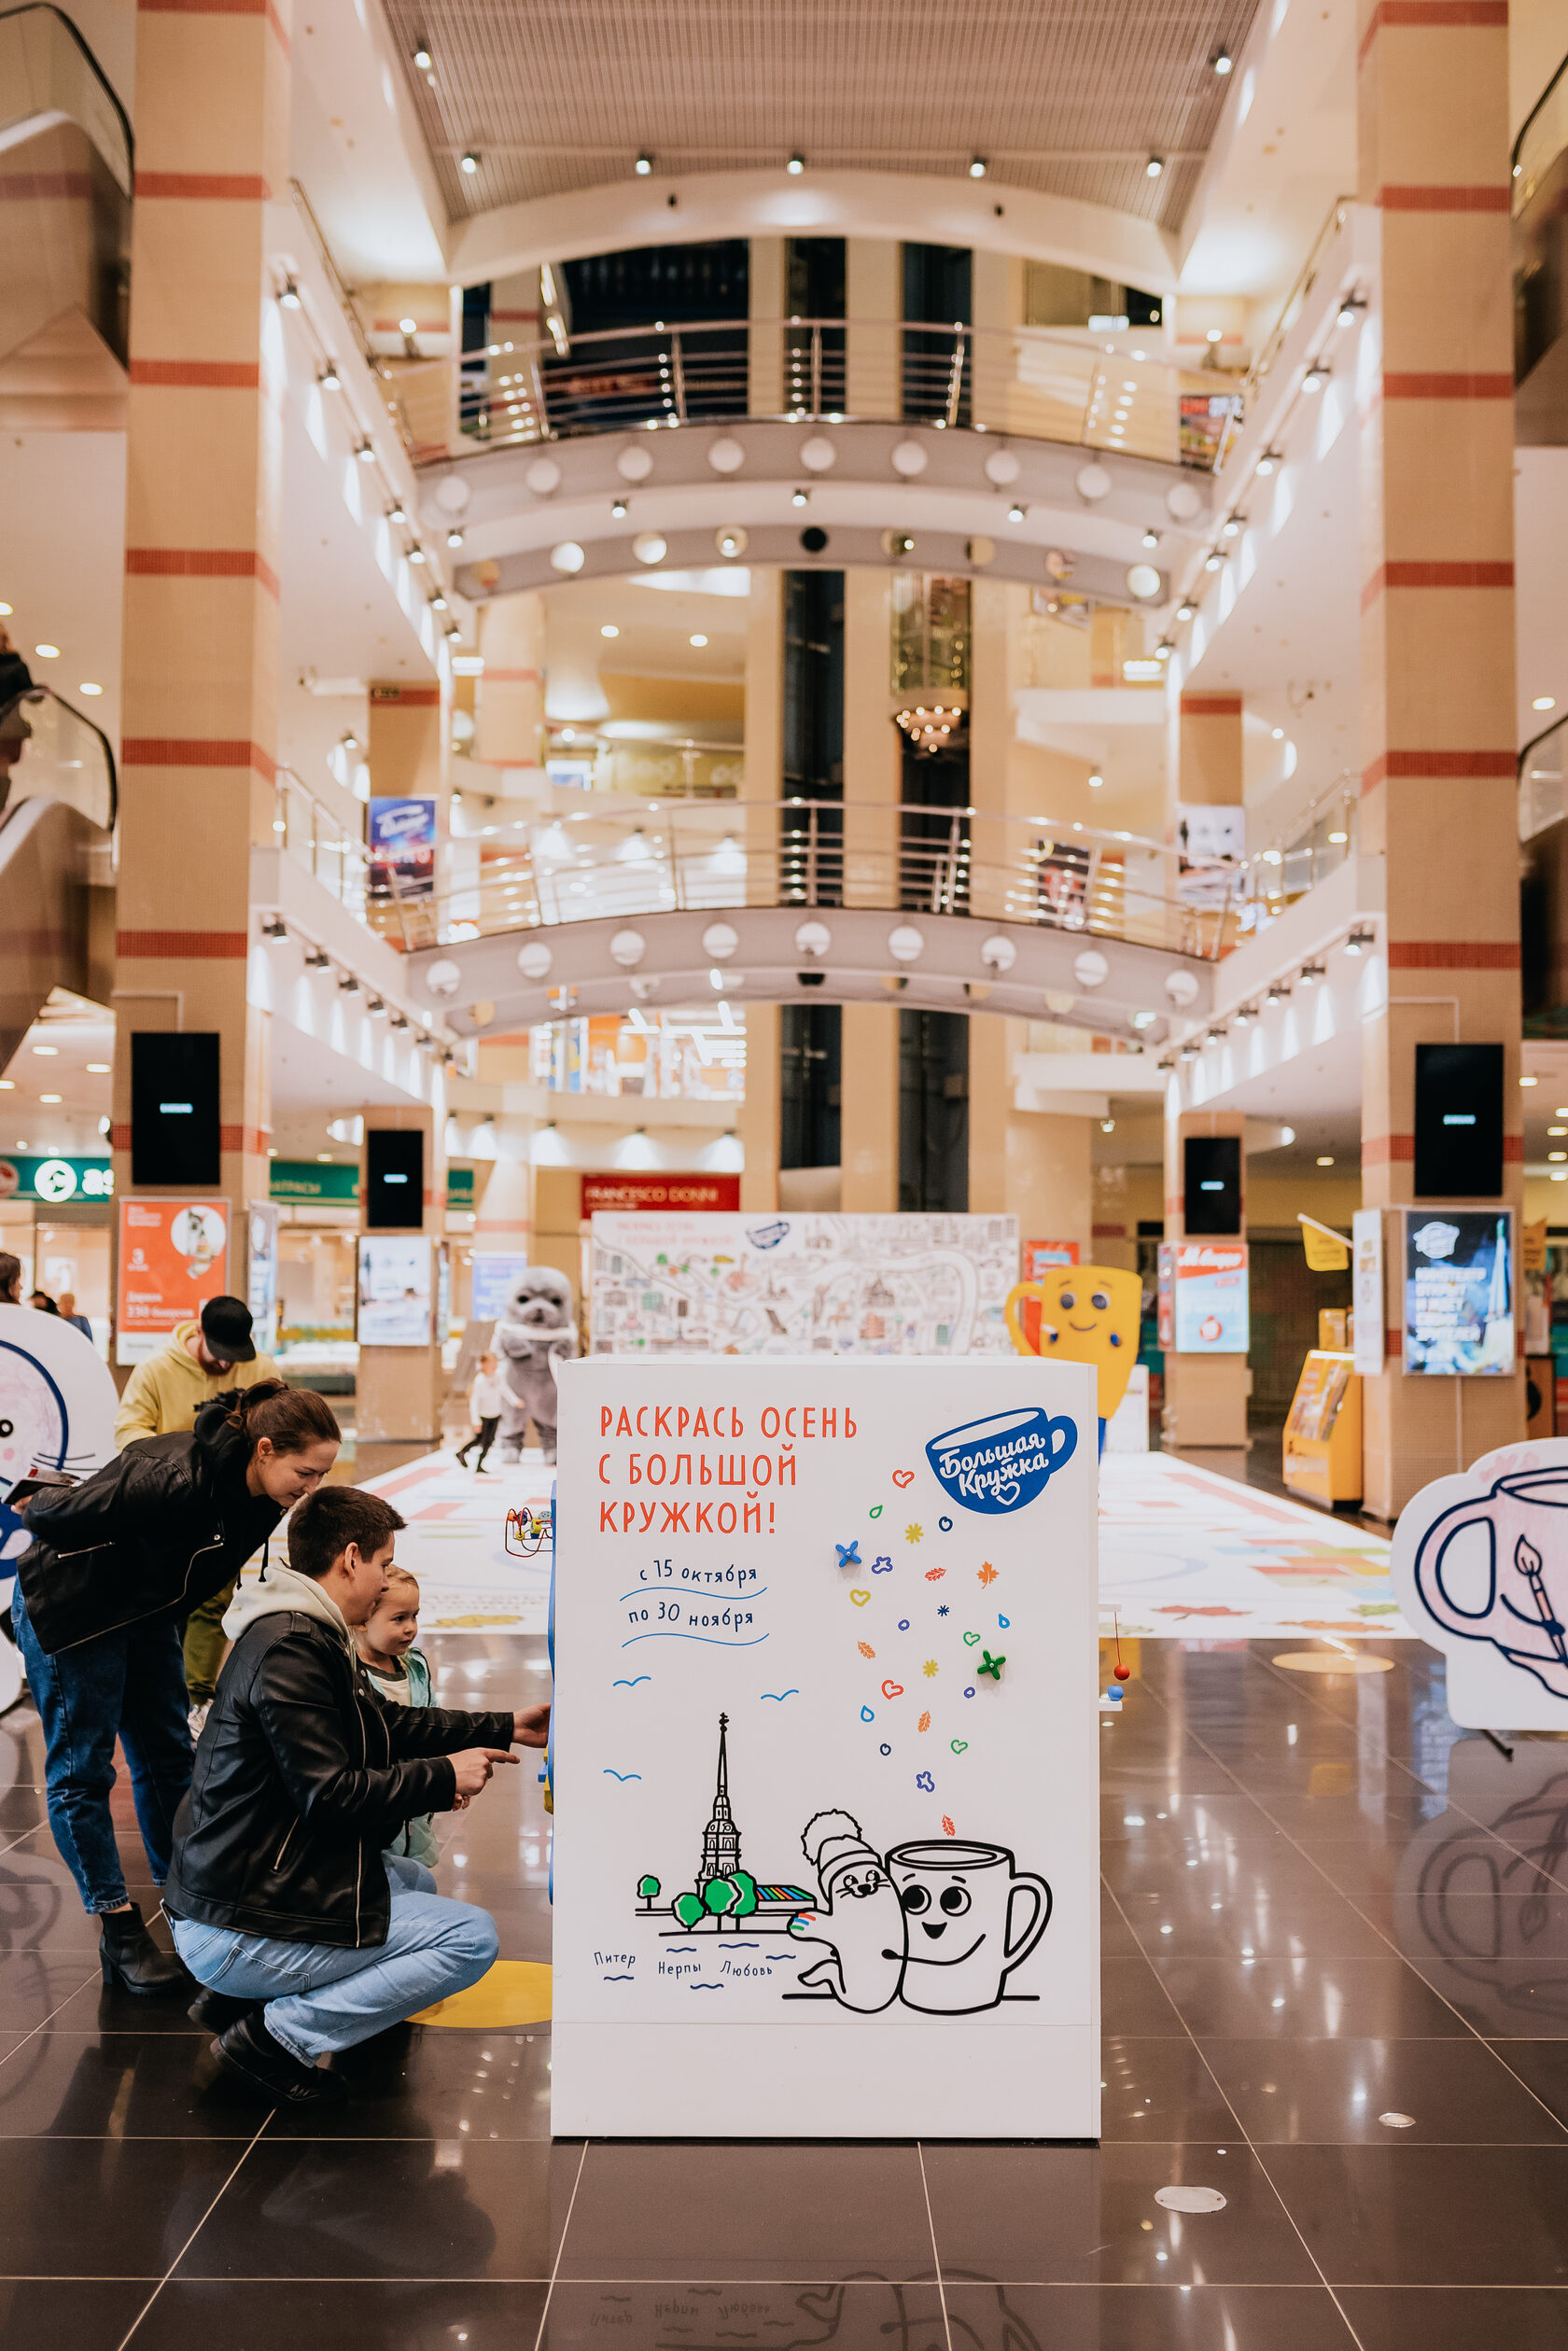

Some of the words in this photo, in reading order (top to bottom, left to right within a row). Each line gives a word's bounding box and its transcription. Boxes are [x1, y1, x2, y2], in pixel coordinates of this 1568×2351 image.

[600, 1406, 745, 1438] РАСКРАСЬ
[761, 1406, 858, 1439] ОСЕНЬ
[598, 1453, 611, 1486] С
[629, 1443, 797, 1487] БОЛЬШОЙ
[939, 1433, 1046, 1479] Большая
[959, 1452, 1049, 1500] Кружка
[599, 1491, 777, 1534] КРУЖКОЙ!
[639, 1569, 648, 1581] с
[653, 1559, 673, 1578] 15
[681, 1563, 757, 1589] октября
[628, 1609, 650, 1624] по
[657, 1602, 680, 1622] 30
[689, 1607, 754, 1633] ноября
[594, 1951, 637, 1969] Питер
[658, 1961, 702, 1980] Нерпы
[720, 1960, 774, 1977] Любовь
